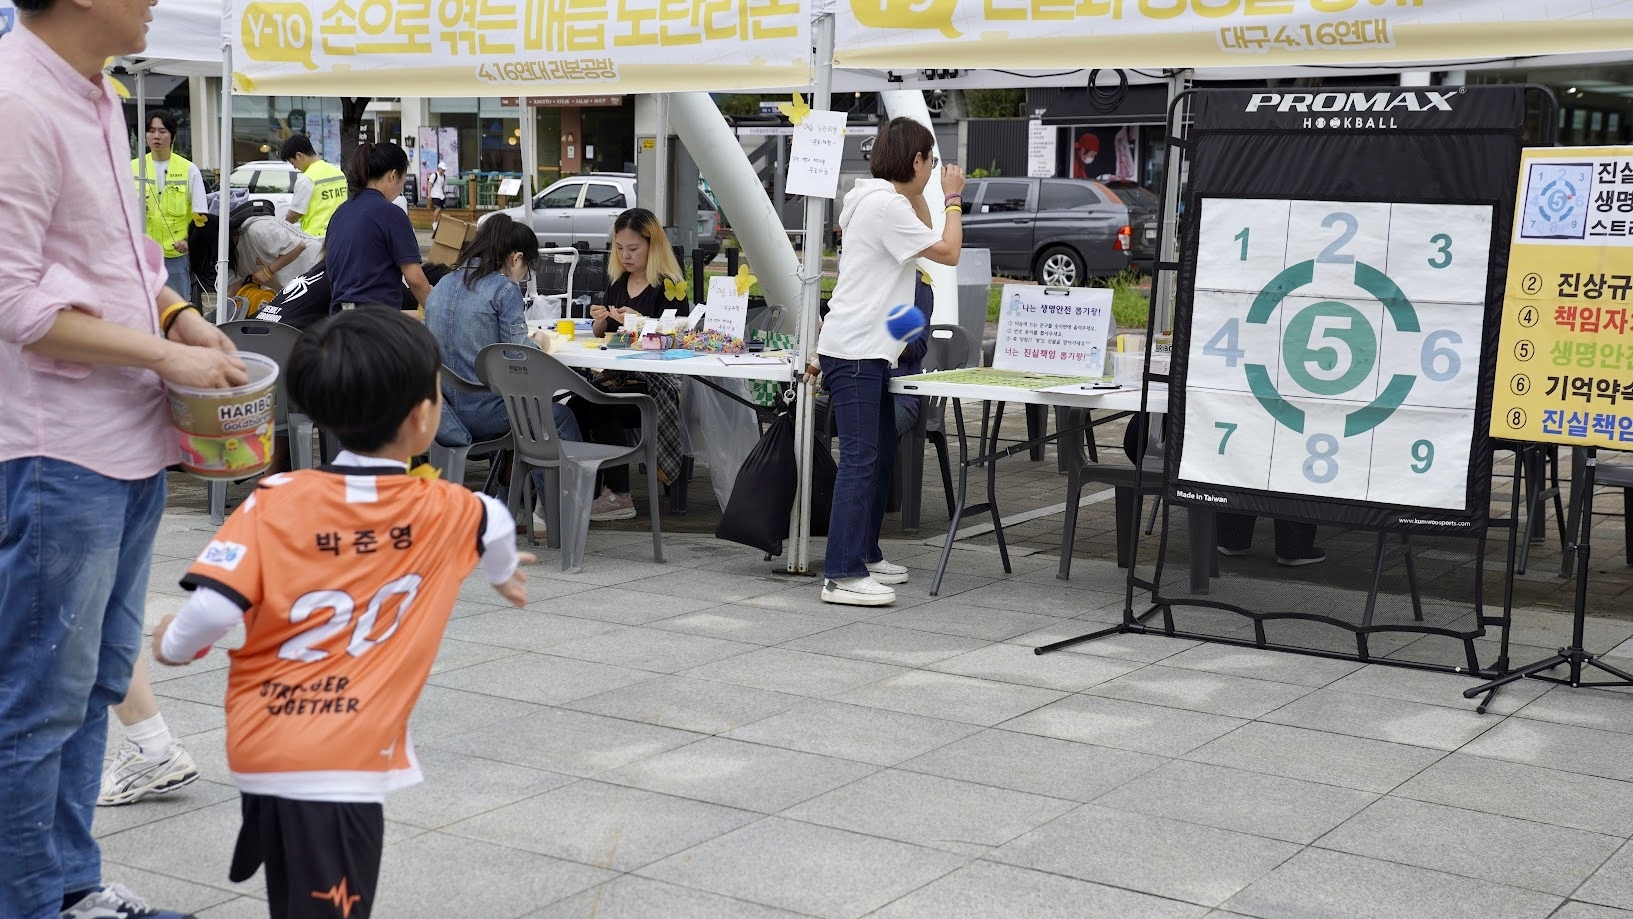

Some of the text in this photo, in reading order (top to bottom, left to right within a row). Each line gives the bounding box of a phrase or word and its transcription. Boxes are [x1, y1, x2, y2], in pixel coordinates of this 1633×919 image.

[248, 13, 306, 48] Y-10
[320, 0, 432, 55] 손으로
[322, 186, 346, 200] STAF
[1234, 212, 1453, 268] 1 2 3
[1590, 220, 1633, 236] 스트
[1022, 304, 1036, 313] 나는
[1040, 304, 1072, 315] 생명안전
[1554, 305, 1633, 334] 책임자
[1005, 348, 1019, 357] 너는
[1024, 348, 1056, 360] 진실책임
[1202, 316, 1464, 382] 4 5 6
[221, 395, 272, 419] HARIBO
[1214, 422, 1434, 484] 7 8 9
[1176, 490, 1195, 499] Made
[1204, 494, 1228, 503] Taiwan
[277, 574, 423, 664] 20
